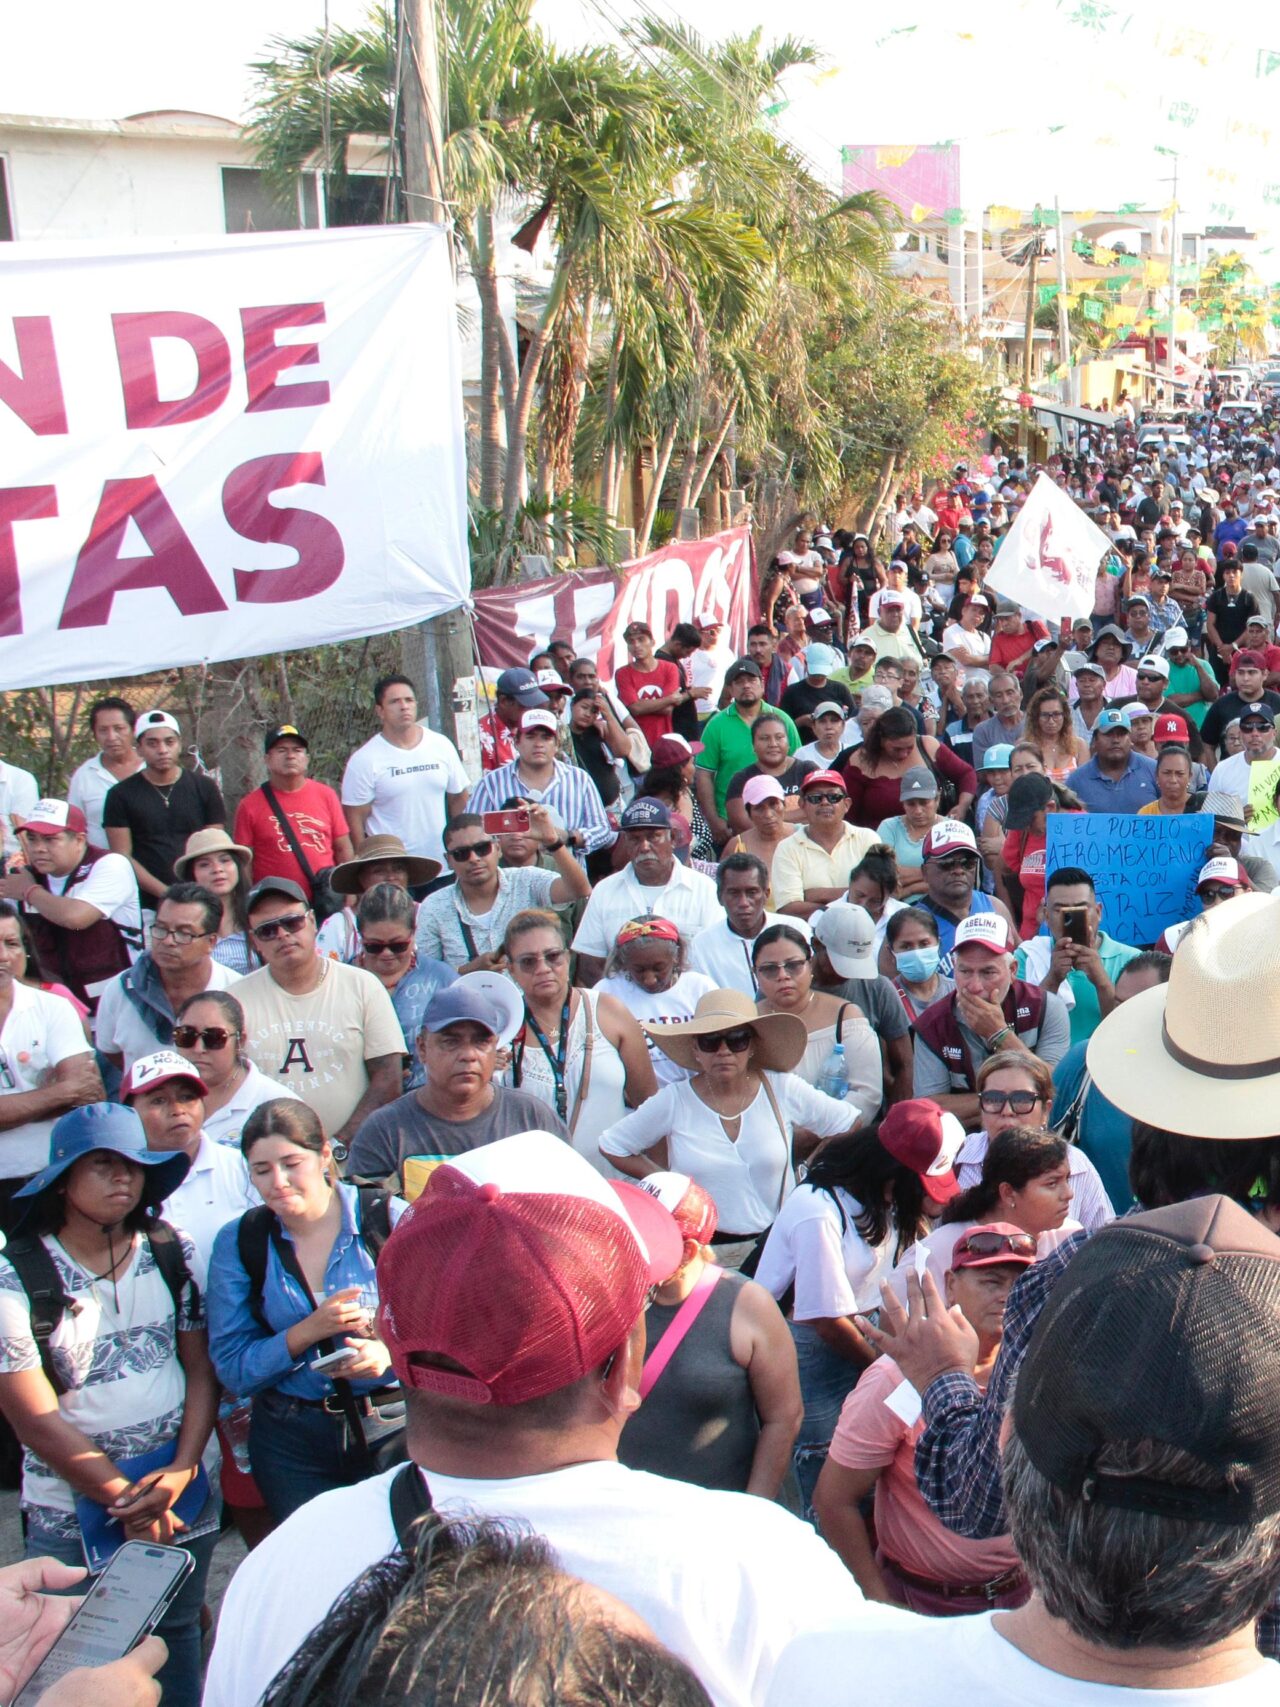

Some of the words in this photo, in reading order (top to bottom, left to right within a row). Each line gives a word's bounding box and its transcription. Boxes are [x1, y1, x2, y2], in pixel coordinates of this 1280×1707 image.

[111, 302, 330, 430] DE
[625, 801, 659, 816] BROOKLYN
[1073, 818, 1097, 835] EL
[1109, 817, 1181, 840] PUEBLO
[1135, 870, 1167, 887] CON
[964, 918, 997, 929] ABELINA
[250, 1020, 344, 1049] AUTHENTIC
[278, 1038, 314, 1073] A
